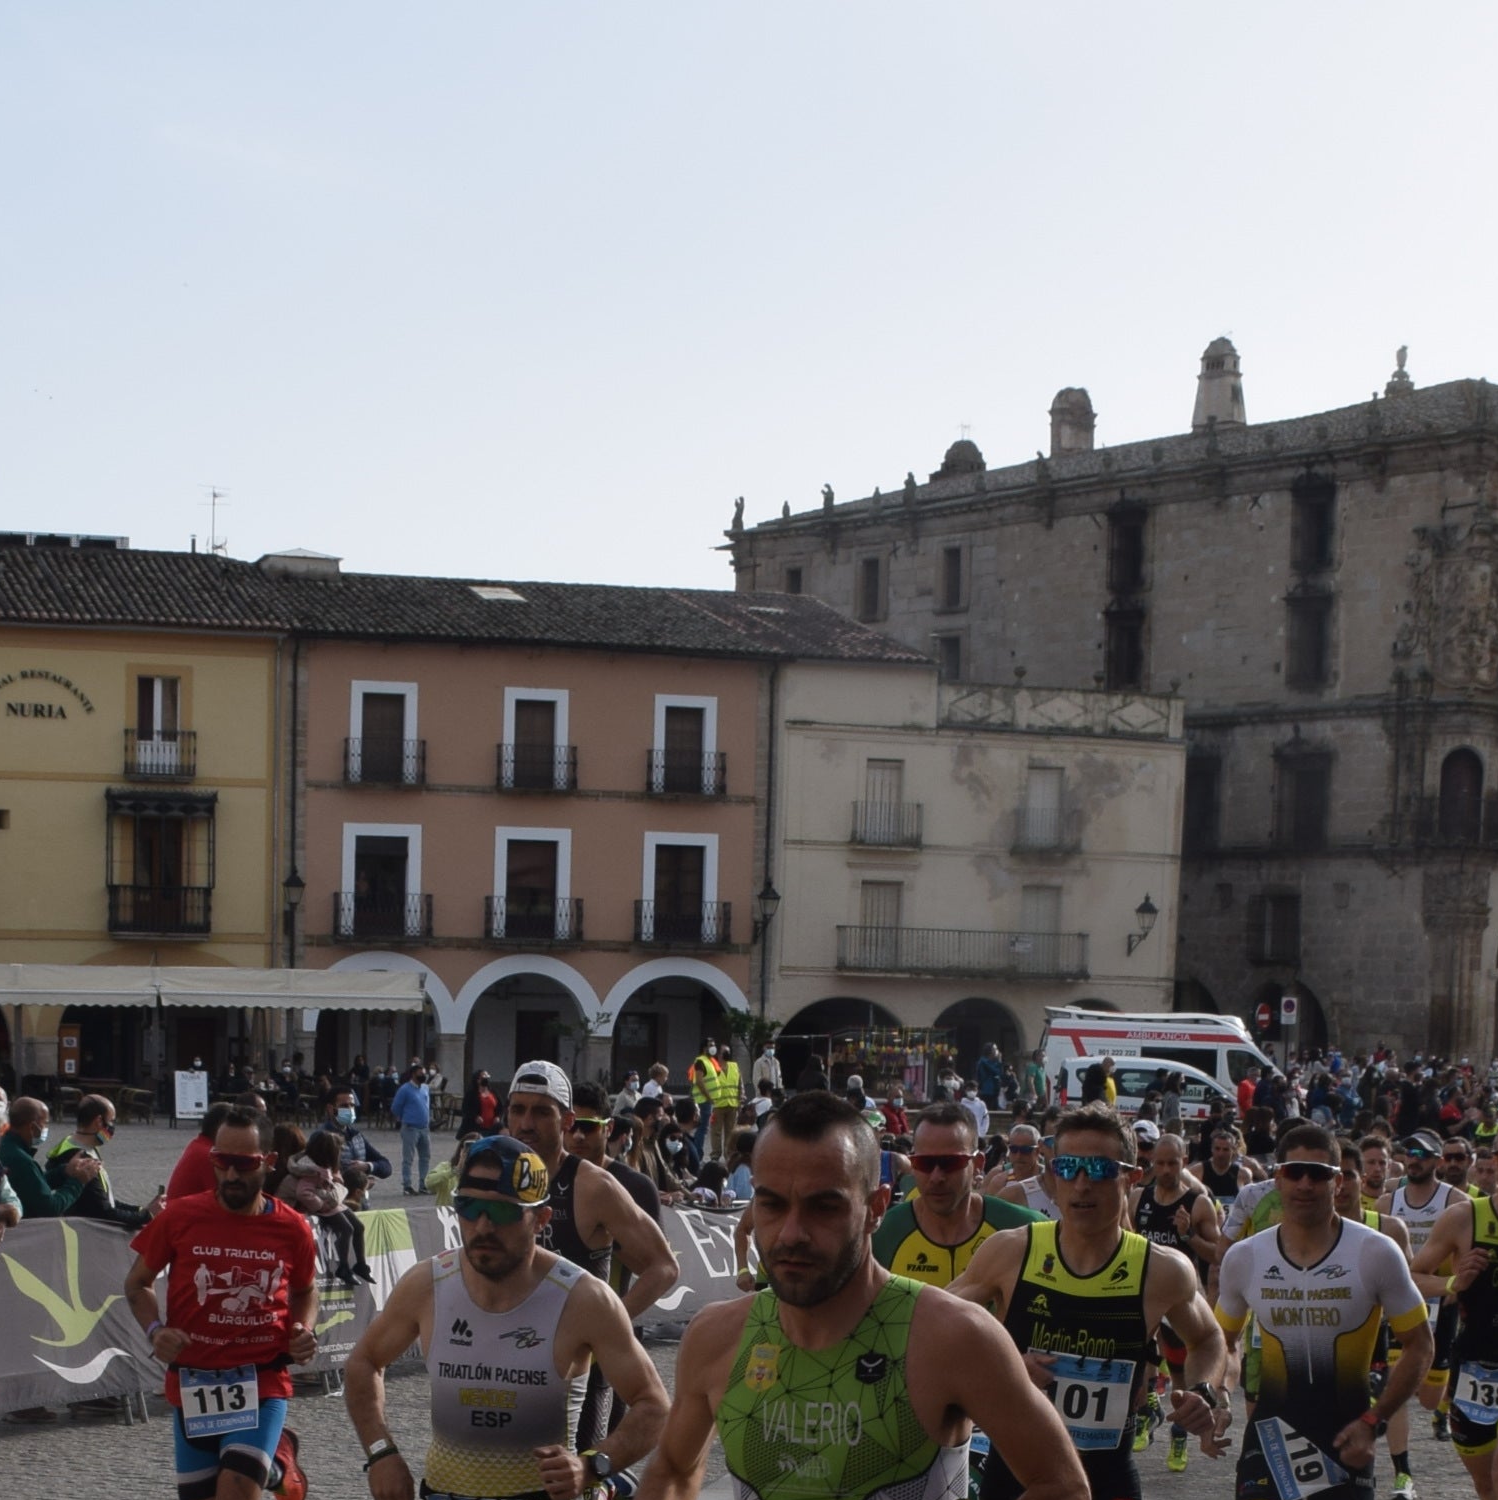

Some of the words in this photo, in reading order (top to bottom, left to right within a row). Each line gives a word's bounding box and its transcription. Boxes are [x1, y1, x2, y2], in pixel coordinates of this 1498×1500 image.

[6, 702, 67, 720] NURIA
[1126, 1031, 1191, 1041] AMBULANCIA
[192, 1246, 221, 1257] CLUB
[224, 1248, 276, 1261] TRIATLÓN
[208, 1311, 278, 1327] BURGUILLOS
[1270, 1306, 1341, 1327] MONTERO
[439, 1362, 492, 1381] TRIATLÓN
[495, 1366, 548, 1386] PACENSE
[193, 1384, 246, 1414] 113
[471, 1410, 513, 1428] ESP
[763, 1400, 862, 1446] VALERIO
[1284, 1431, 1324, 1483] 119
